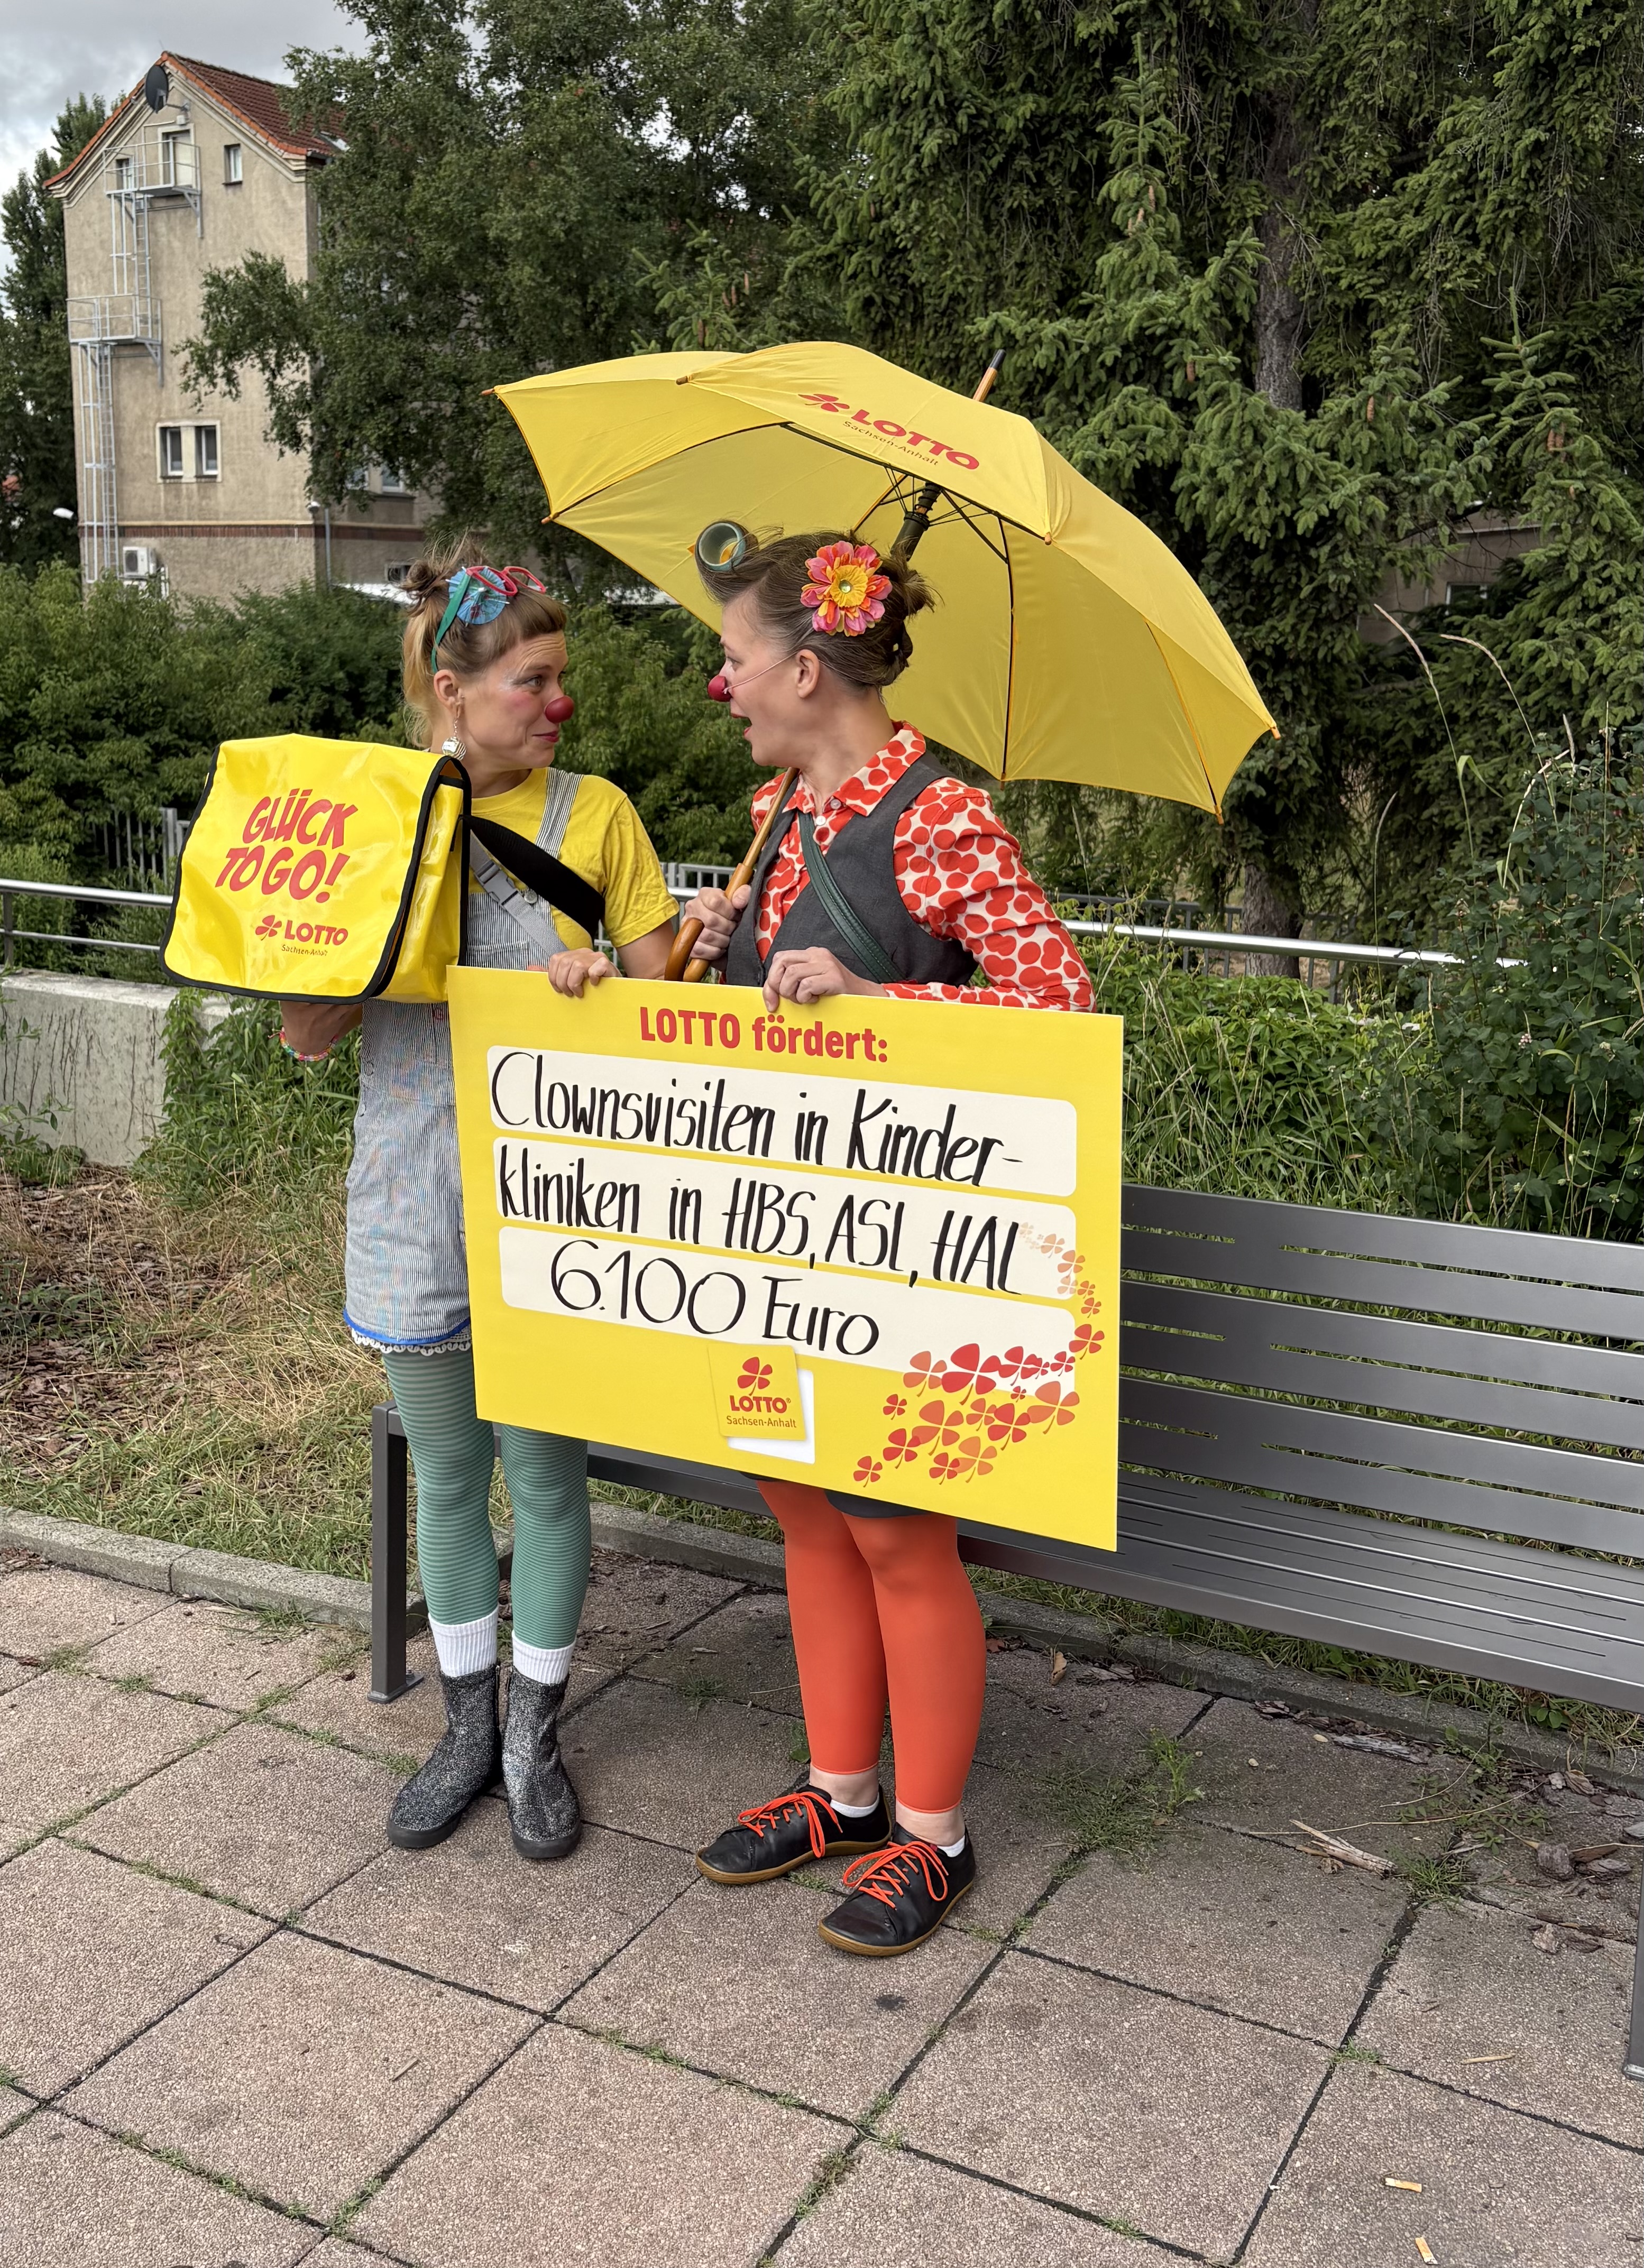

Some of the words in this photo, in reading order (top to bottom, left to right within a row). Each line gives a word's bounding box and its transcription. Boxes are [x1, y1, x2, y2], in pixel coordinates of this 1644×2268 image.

[843, 421, 939, 466] Sachsen-Anhalt
[851, 409, 979, 469] LOTTO
[242, 788, 358, 850] GLÜCK
[215, 845, 264, 891] TO
[261, 847, 350, 903] GO!
[284, 920, 348, 946] LOTTO
[640, 1007, 740, 1048] LOTTO
[752, 1015, 887, 1063] fördert:
[492, 1052, 776, 1157] Clownsvisiten
[794, 1091, 829, 1166] in
[846, 1089, 1024, 1187] Kinder-
[668, 1178, 702, 1244] in
[930, 1210, 1022, 1295] HAL
[551, 1240, 746, 1334] 6.100
[761, 1276, 879, 1356] Euro
[726, 1415, 797, 1428] Sachsen-Anhalt
